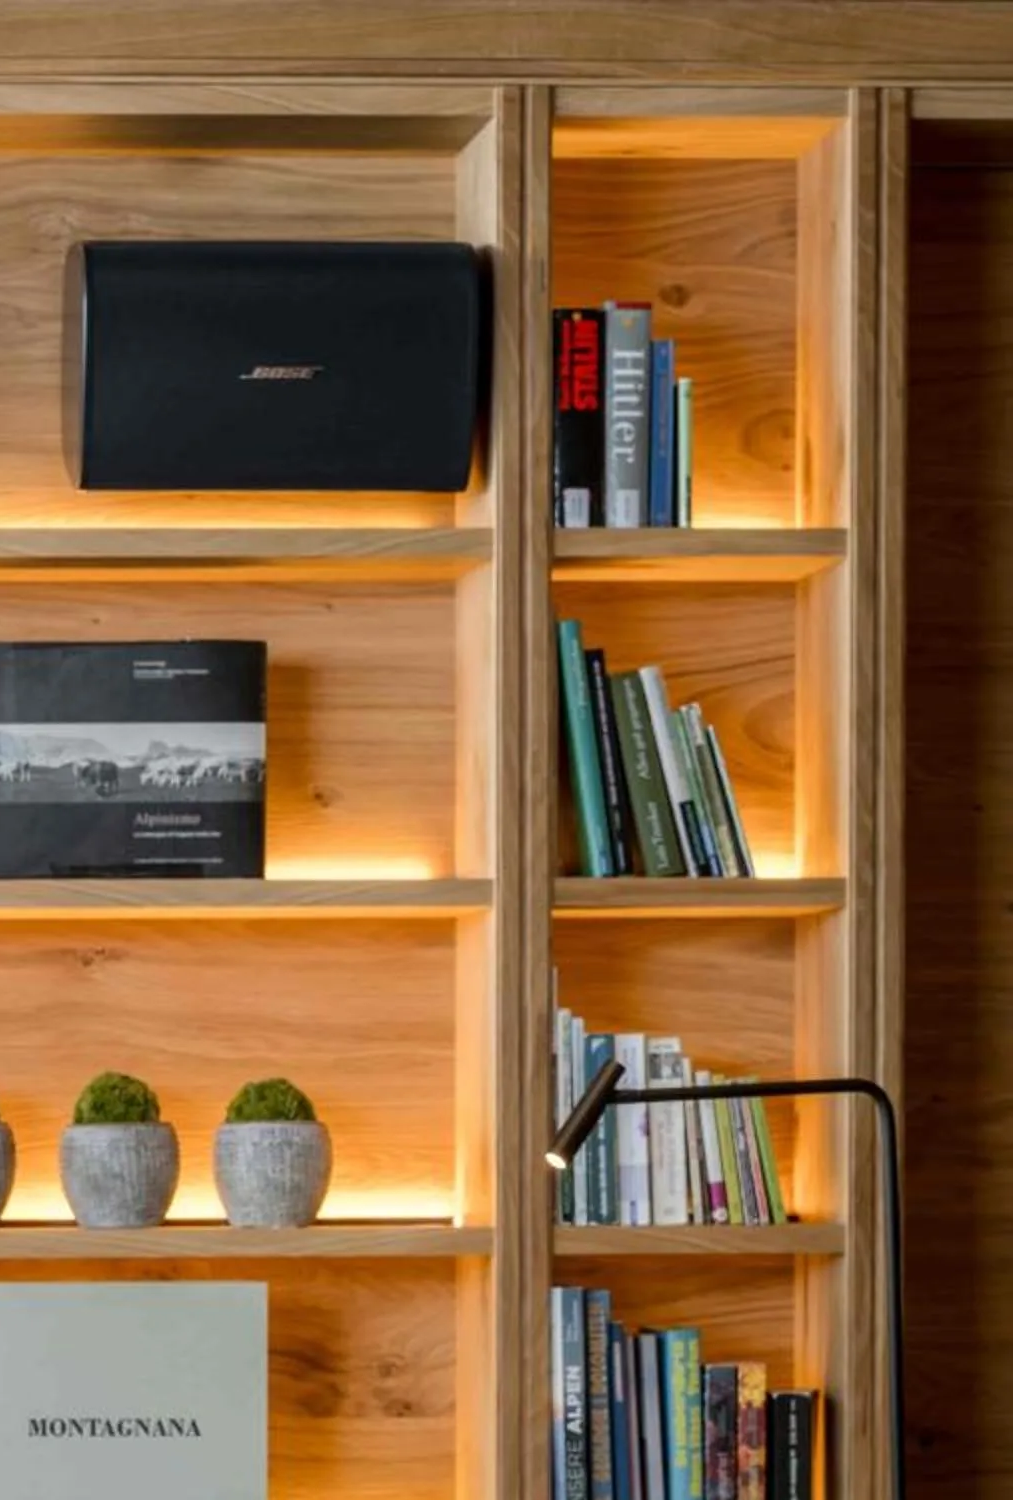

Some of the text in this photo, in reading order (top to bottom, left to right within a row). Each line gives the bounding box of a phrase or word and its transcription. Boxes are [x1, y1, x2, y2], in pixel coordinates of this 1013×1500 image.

[573, 320, 598, 412] STALIN
[612, 349, 645, 464] Hitler
[28, 1418, 201, 1438] MONTAGNANA
[566, 1365, 584, 1433] ALPEN
